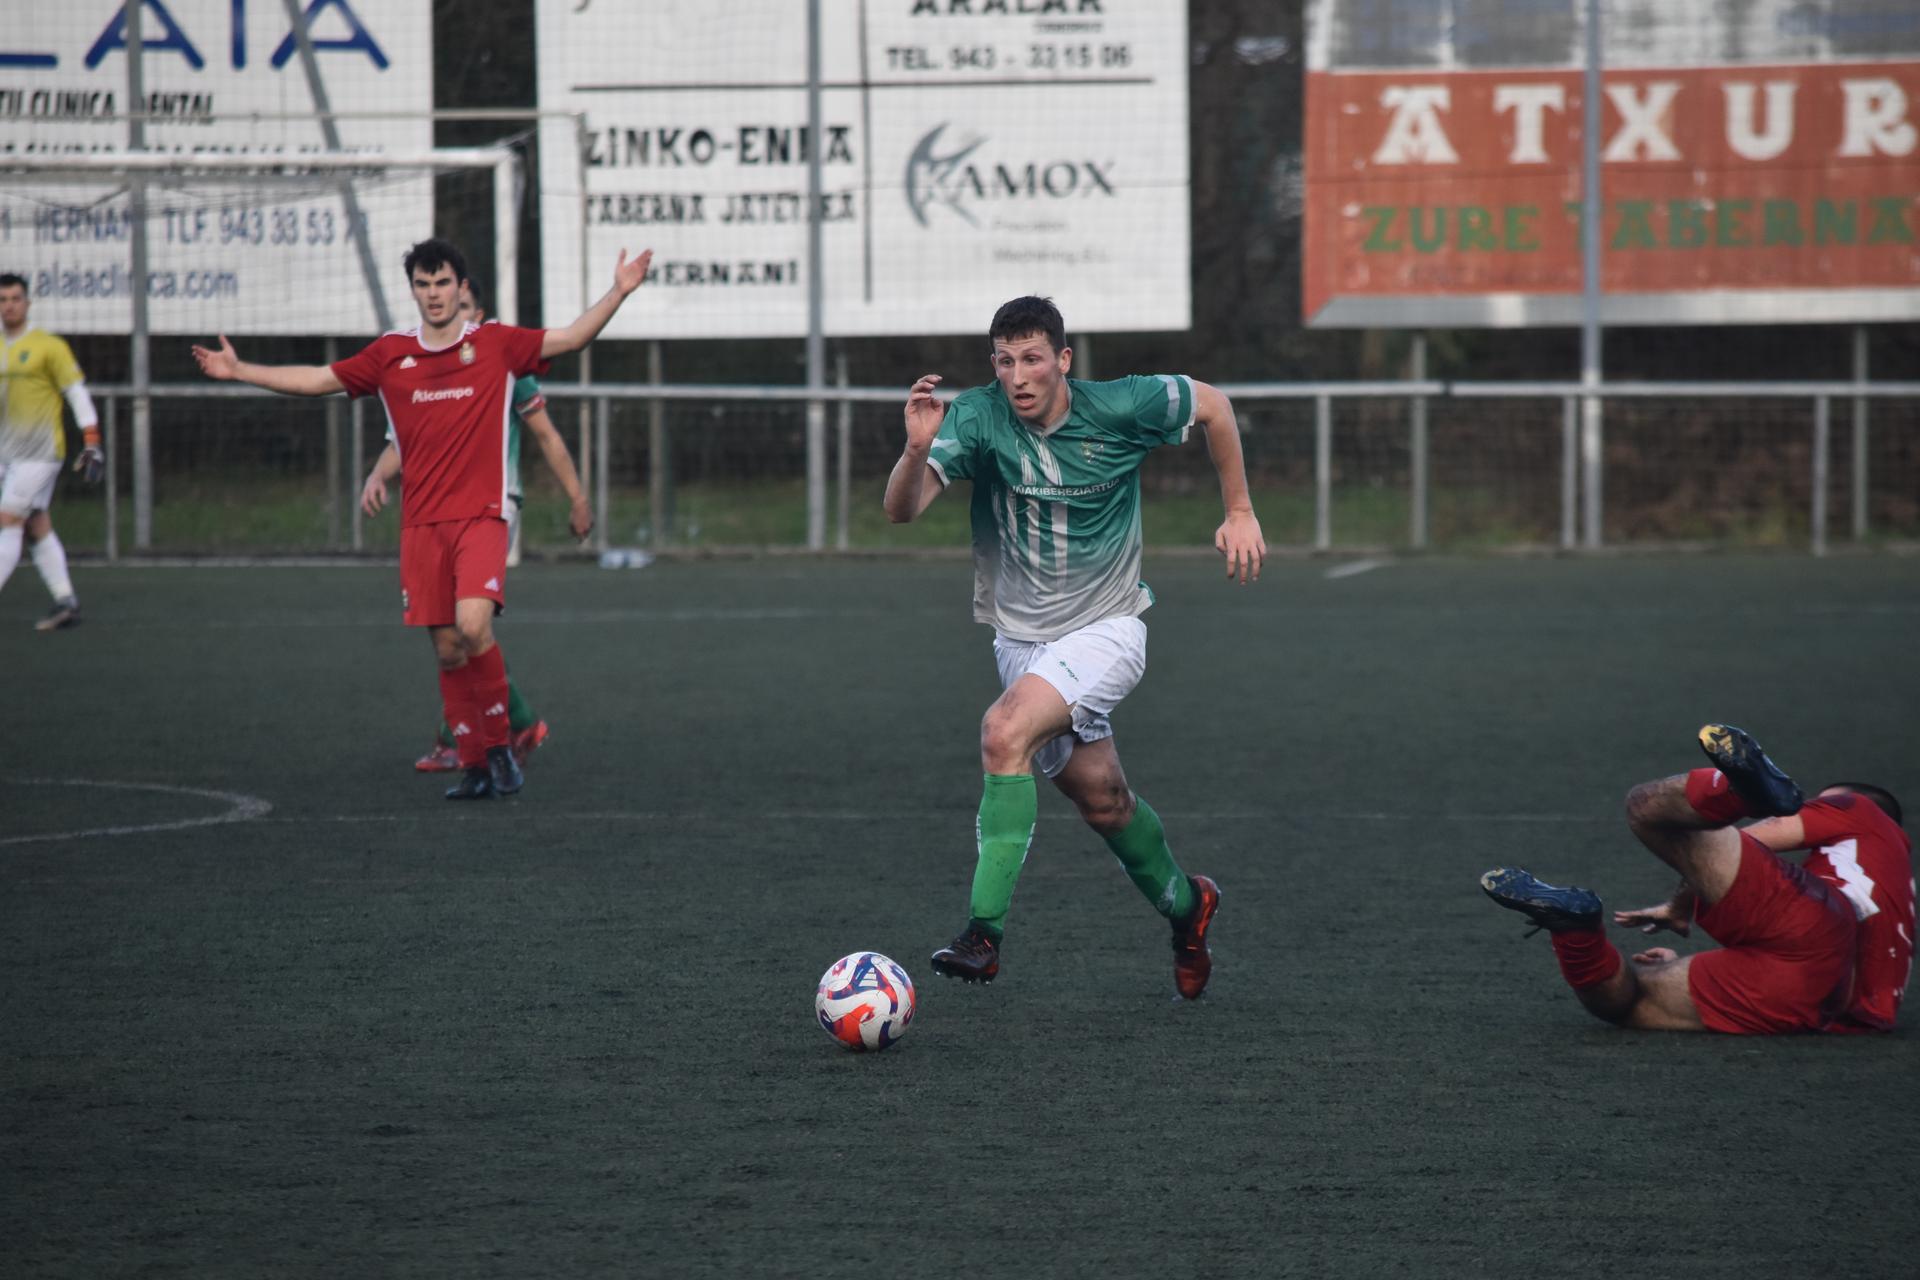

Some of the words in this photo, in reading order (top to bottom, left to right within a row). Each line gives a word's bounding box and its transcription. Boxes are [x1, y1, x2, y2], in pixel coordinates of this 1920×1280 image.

[0, 0, 390, 71] AIA
[143, 91, 214, 125] ENTAL
[1372, 78, 1919, 165] ATXUR
[34, 207, 143, 243] HERNAN
[219, 207, 265, 246] 943
[719, 192, 856, 223] JATETEA
[1360, 207, 1541, 253] ZURE
[412, 386, 474, 404] Alcampo
